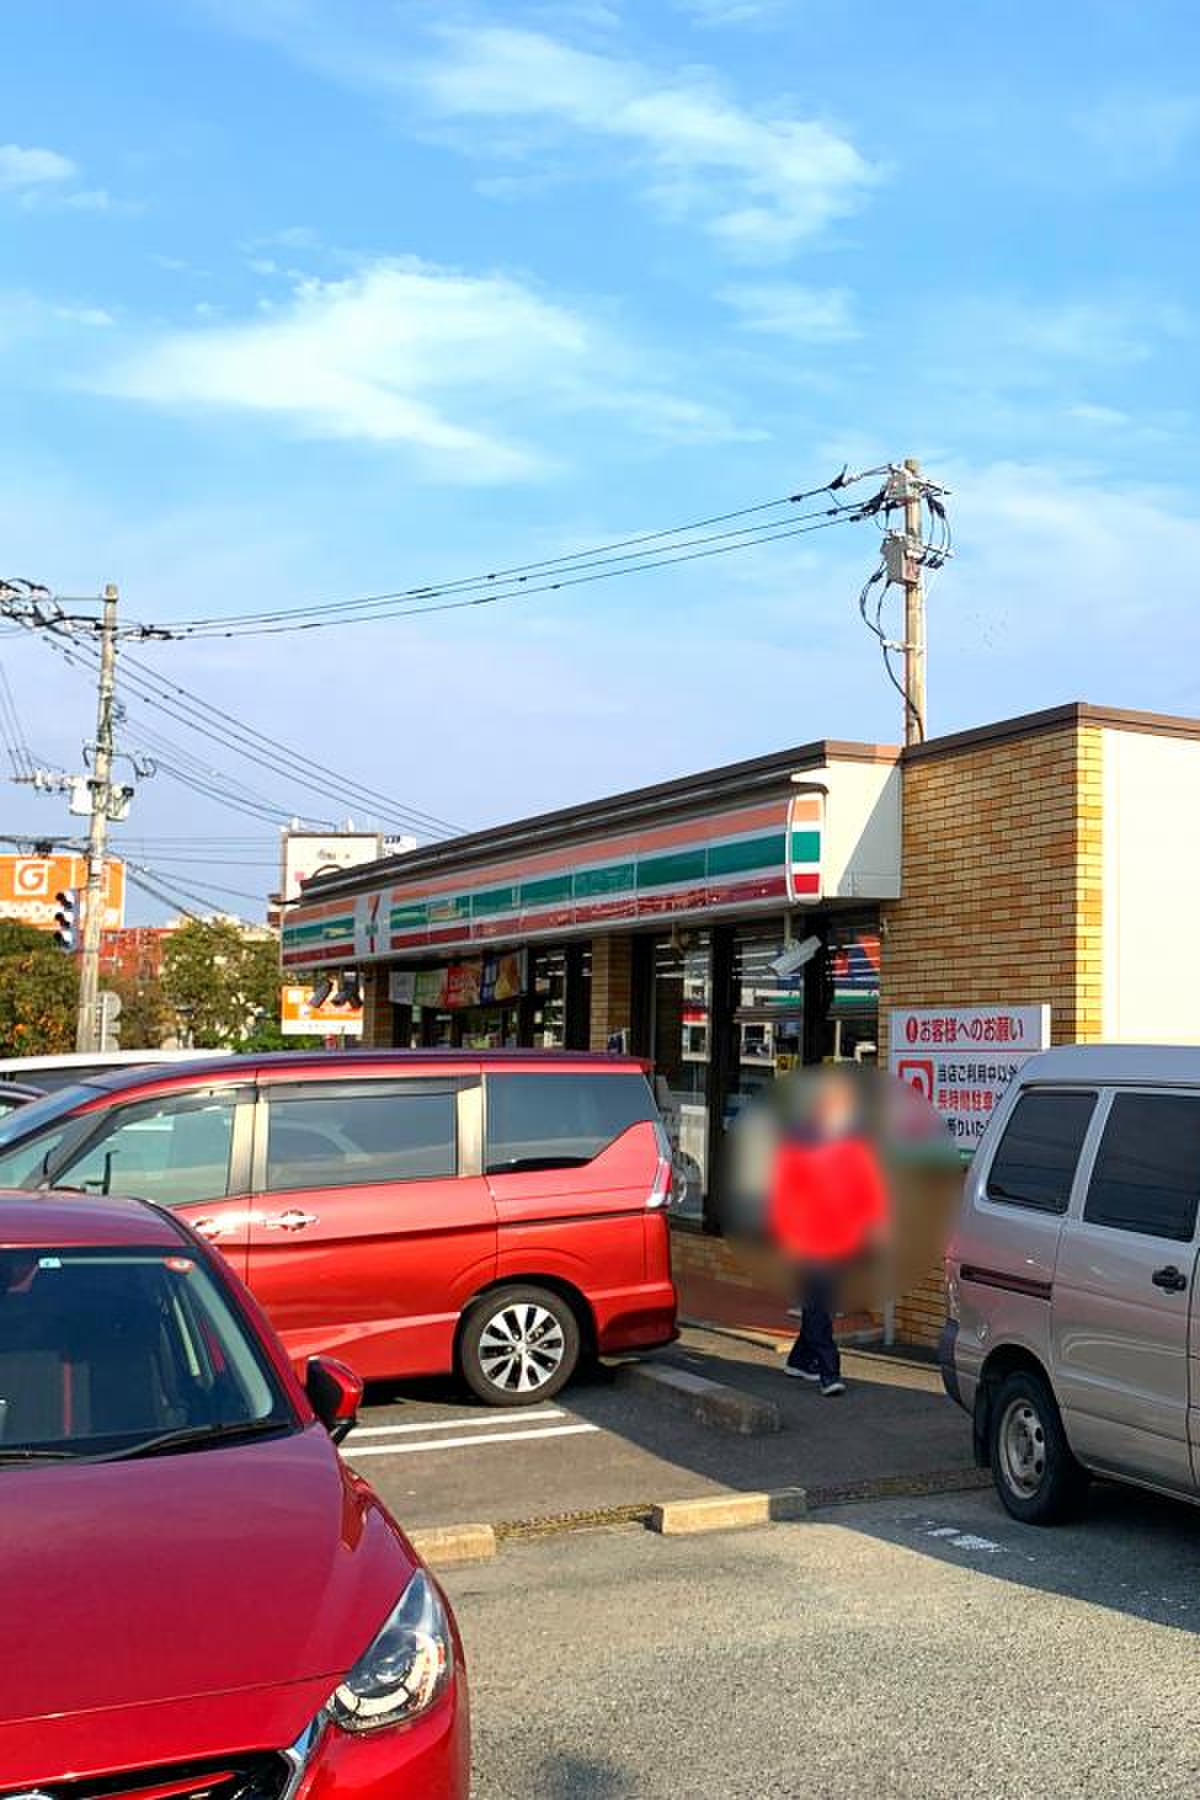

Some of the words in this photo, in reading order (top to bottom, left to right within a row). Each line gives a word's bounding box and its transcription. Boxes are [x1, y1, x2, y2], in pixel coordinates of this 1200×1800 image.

[920, 1016, 1024, 1043] お客様へのお願い
